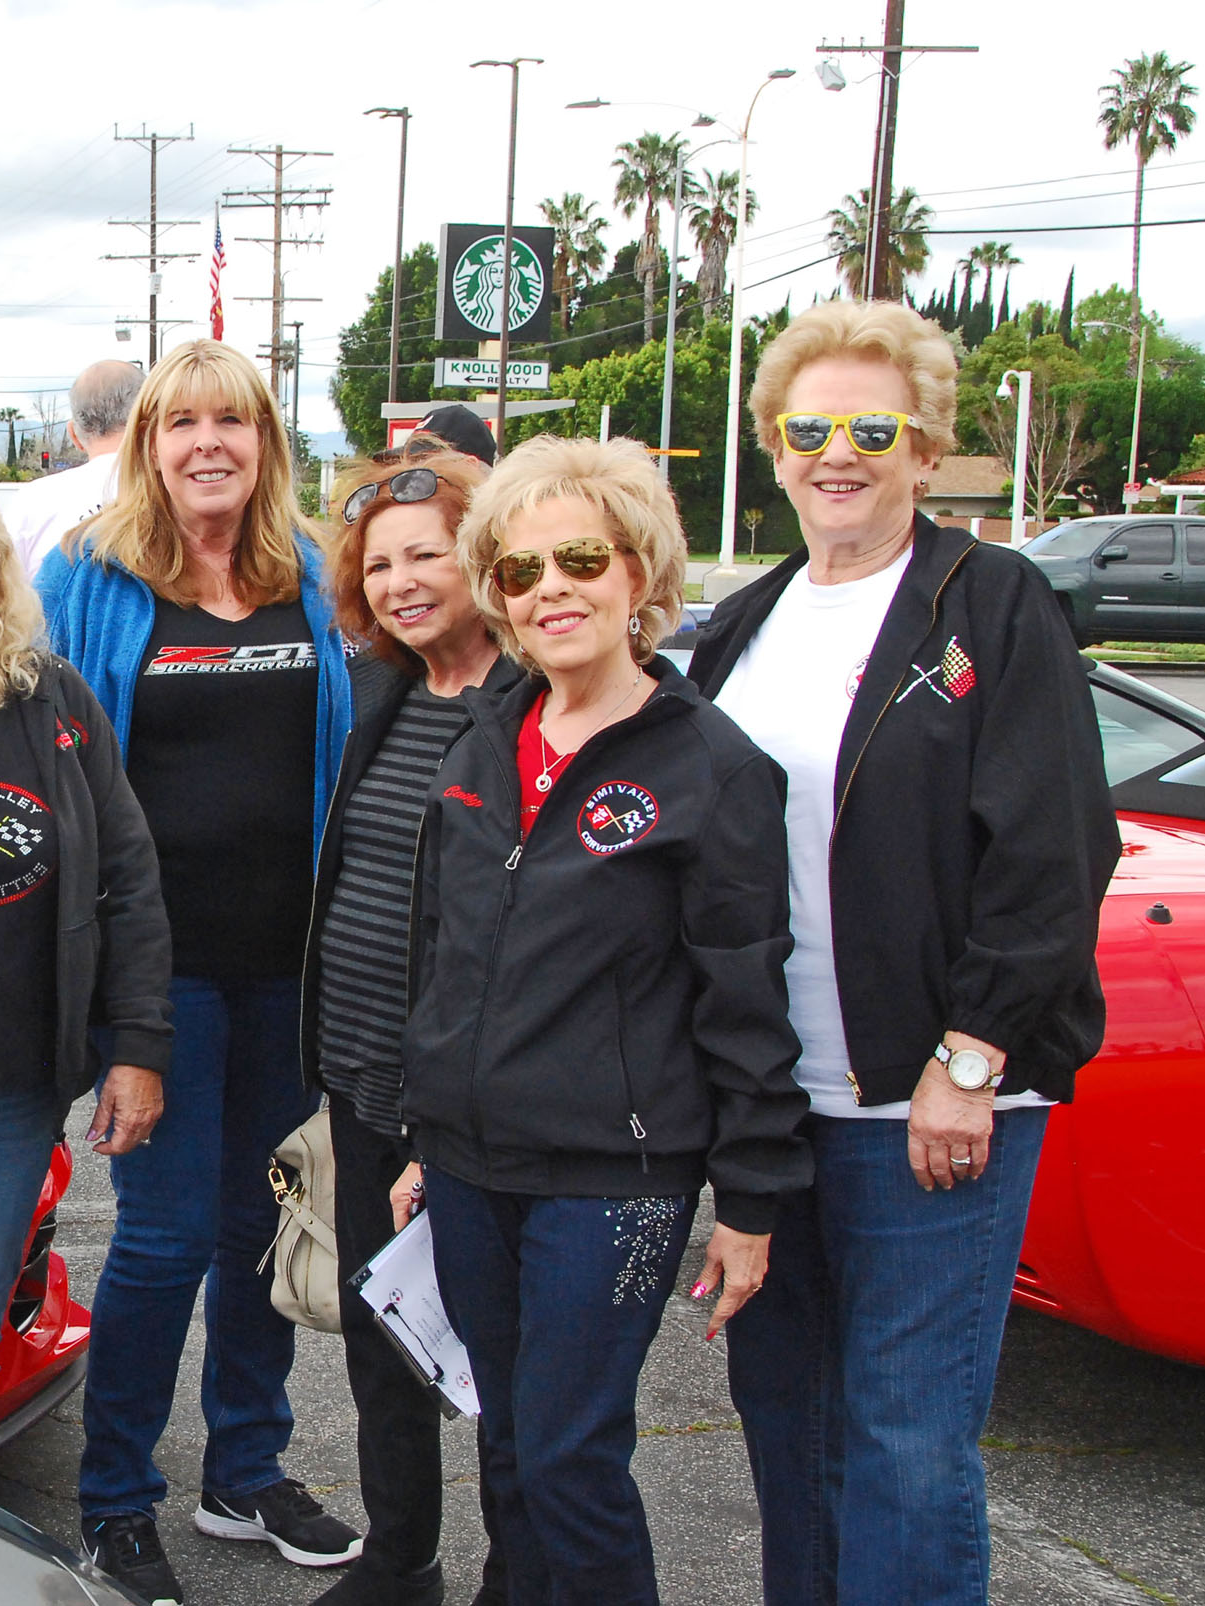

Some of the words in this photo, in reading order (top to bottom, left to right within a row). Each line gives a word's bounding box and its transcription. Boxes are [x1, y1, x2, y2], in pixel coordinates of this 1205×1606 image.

[487, 376, 530, 385] RELTY
[146, 659, 316, 675] SUPERCHARGE
[586, 785, 614, 810] SIMI
[617, 784, 656, 820] VALLEY
